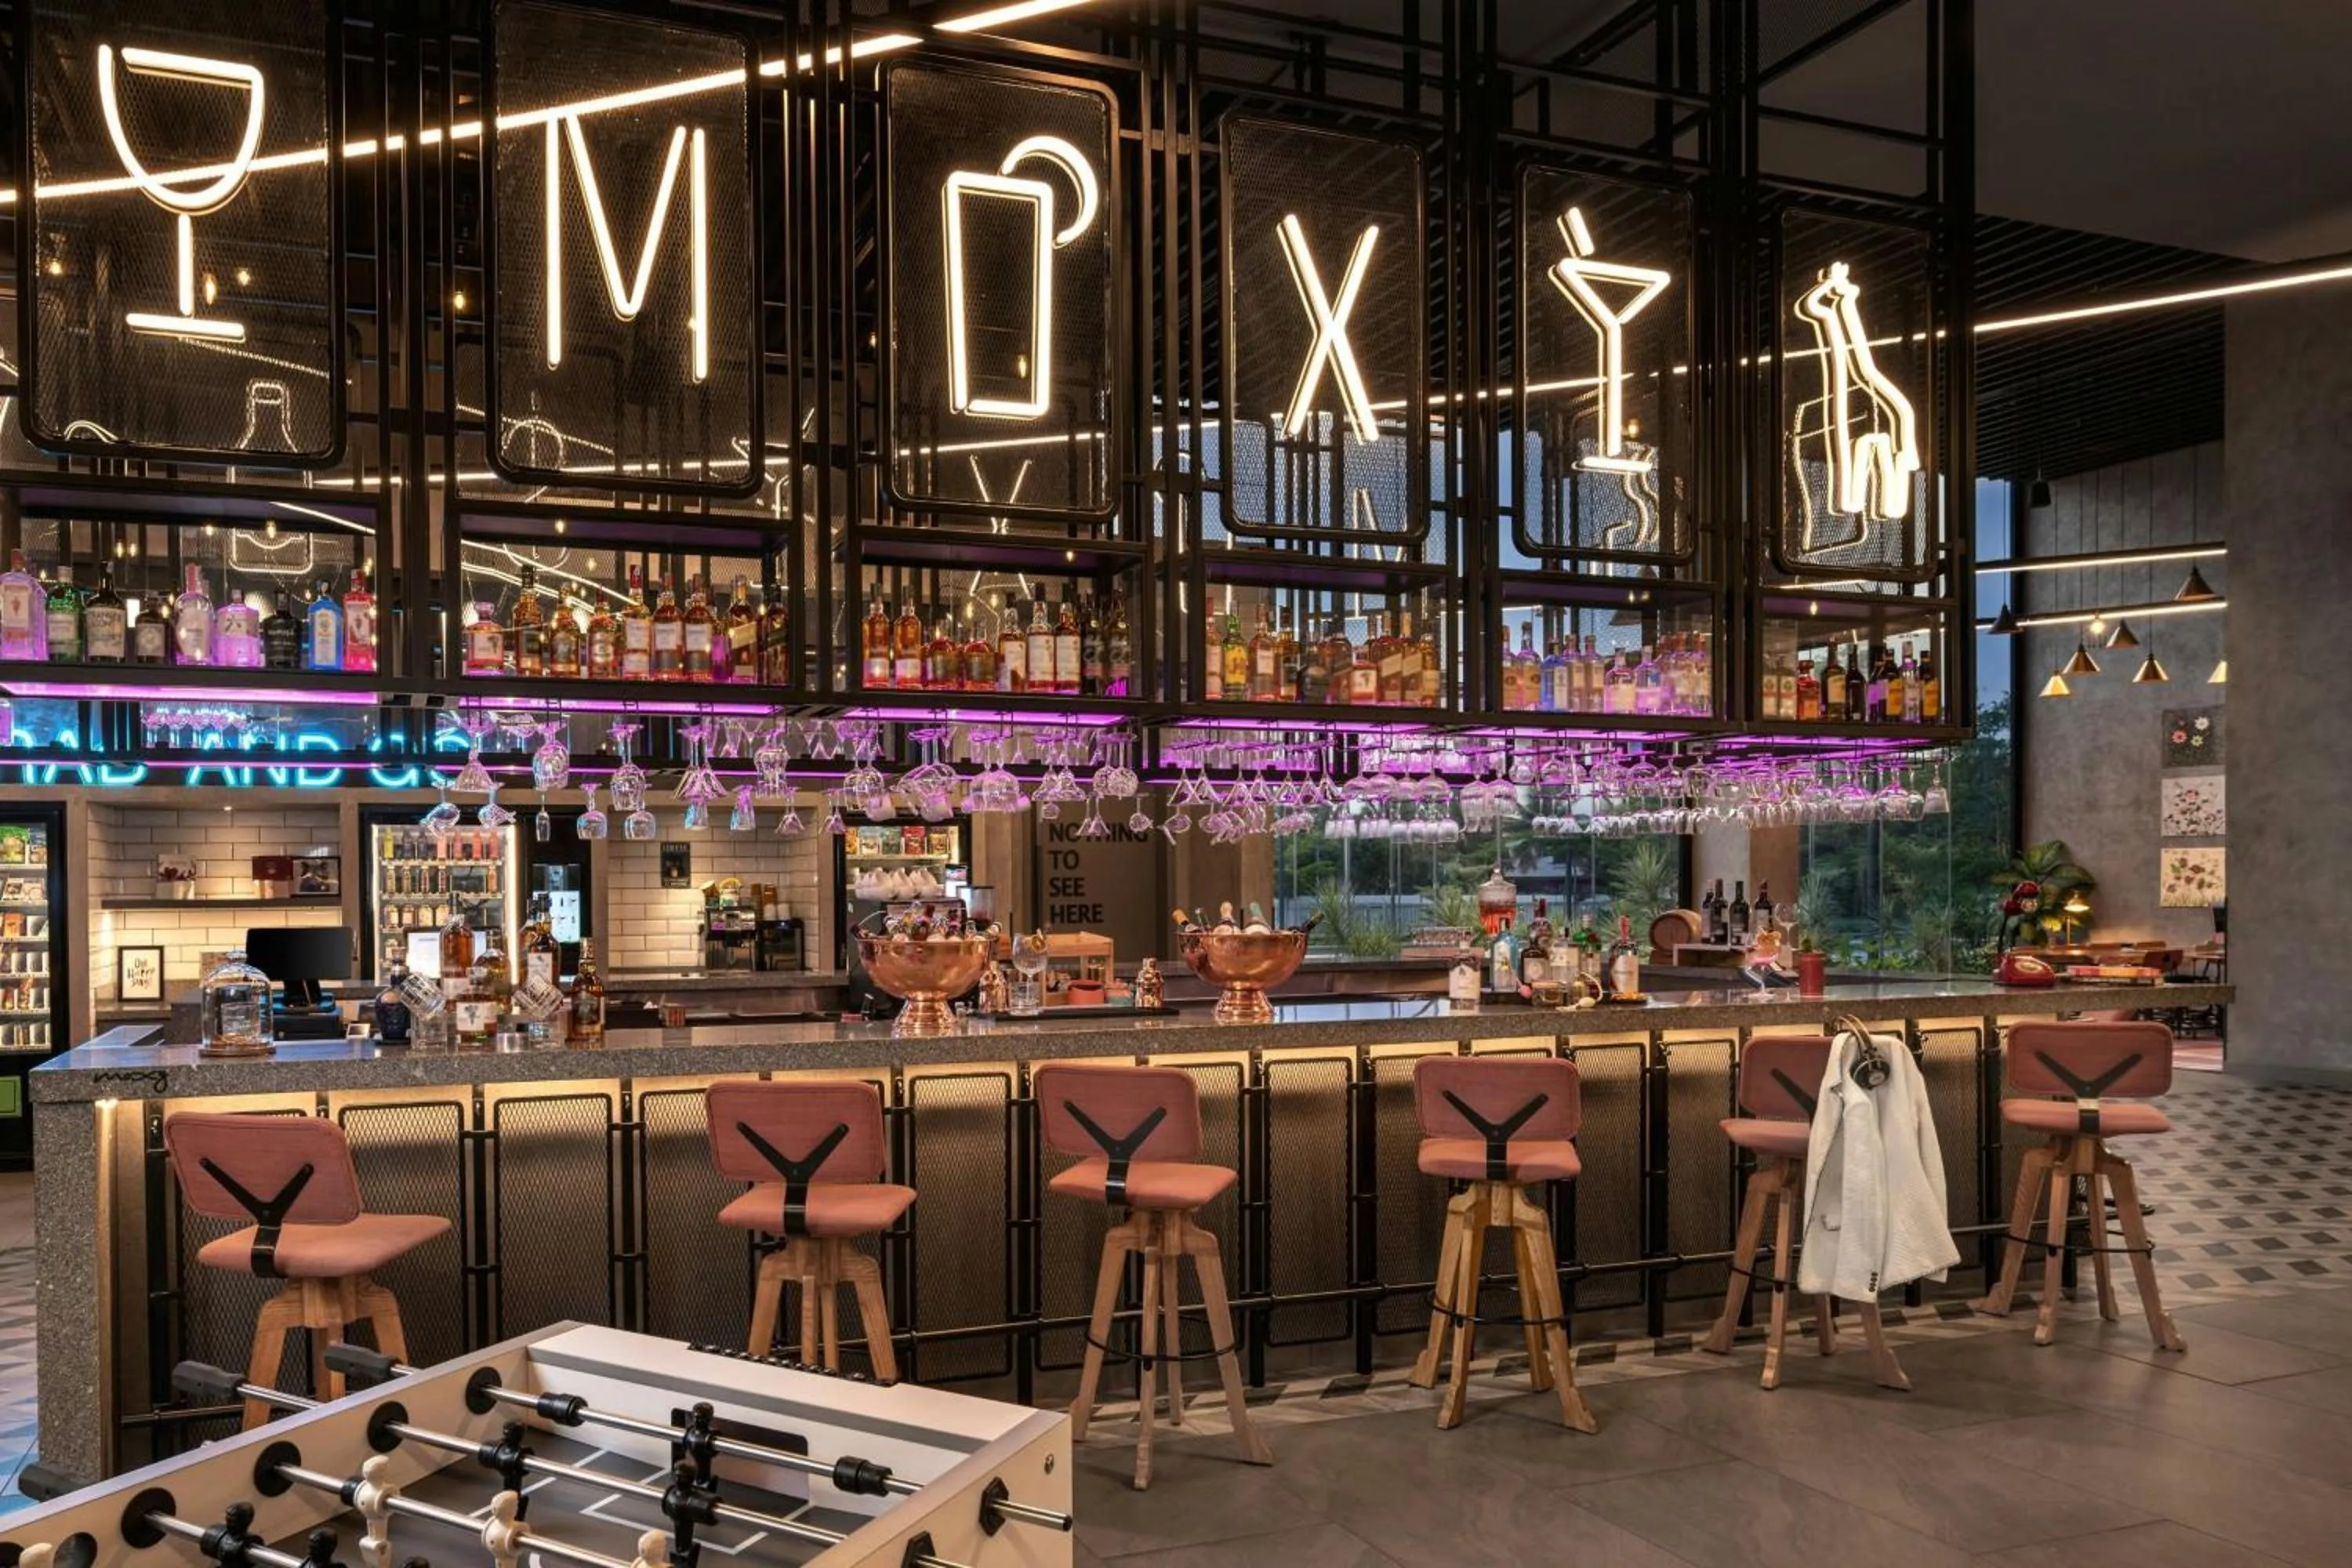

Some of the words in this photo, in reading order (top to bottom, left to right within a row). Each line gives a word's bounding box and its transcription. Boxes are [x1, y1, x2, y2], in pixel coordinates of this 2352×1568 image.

[545, 108, 707, 383] M
[1281, 213, 1380, 442] X
[183, 731, 341, 786] AND
[1047, 849, 1080, 870] TO
[1048, 877, 1086, 898] SEE
[1049, 903, 1105, 924] HERE
